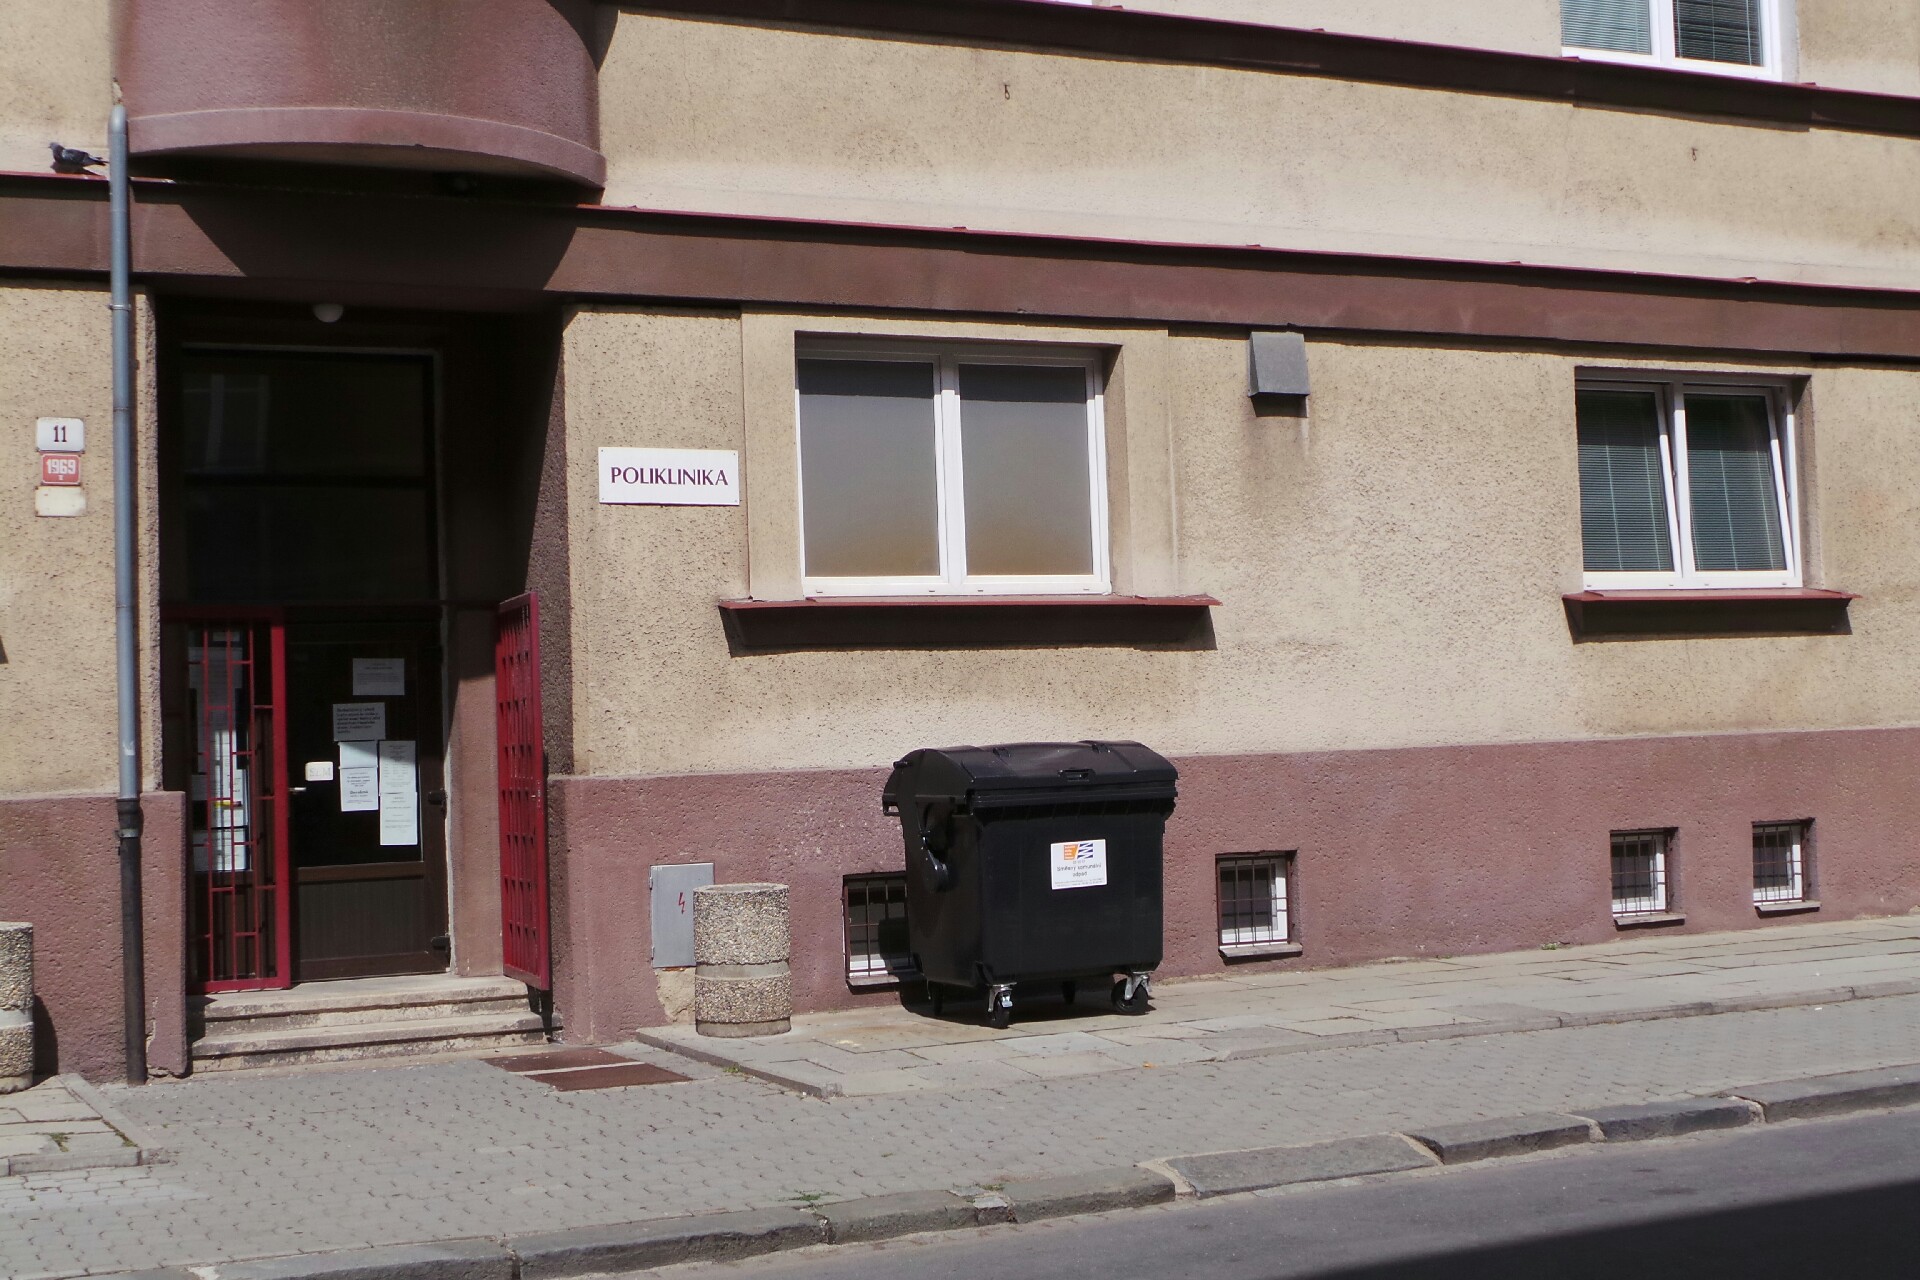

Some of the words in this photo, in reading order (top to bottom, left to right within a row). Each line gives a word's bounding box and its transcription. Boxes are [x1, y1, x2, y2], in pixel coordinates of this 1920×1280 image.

[53, 425, 68, 443] 11
[46, 459, 76, 475] 1969
[610, 466, 729, 486] POLIKLINIKA
